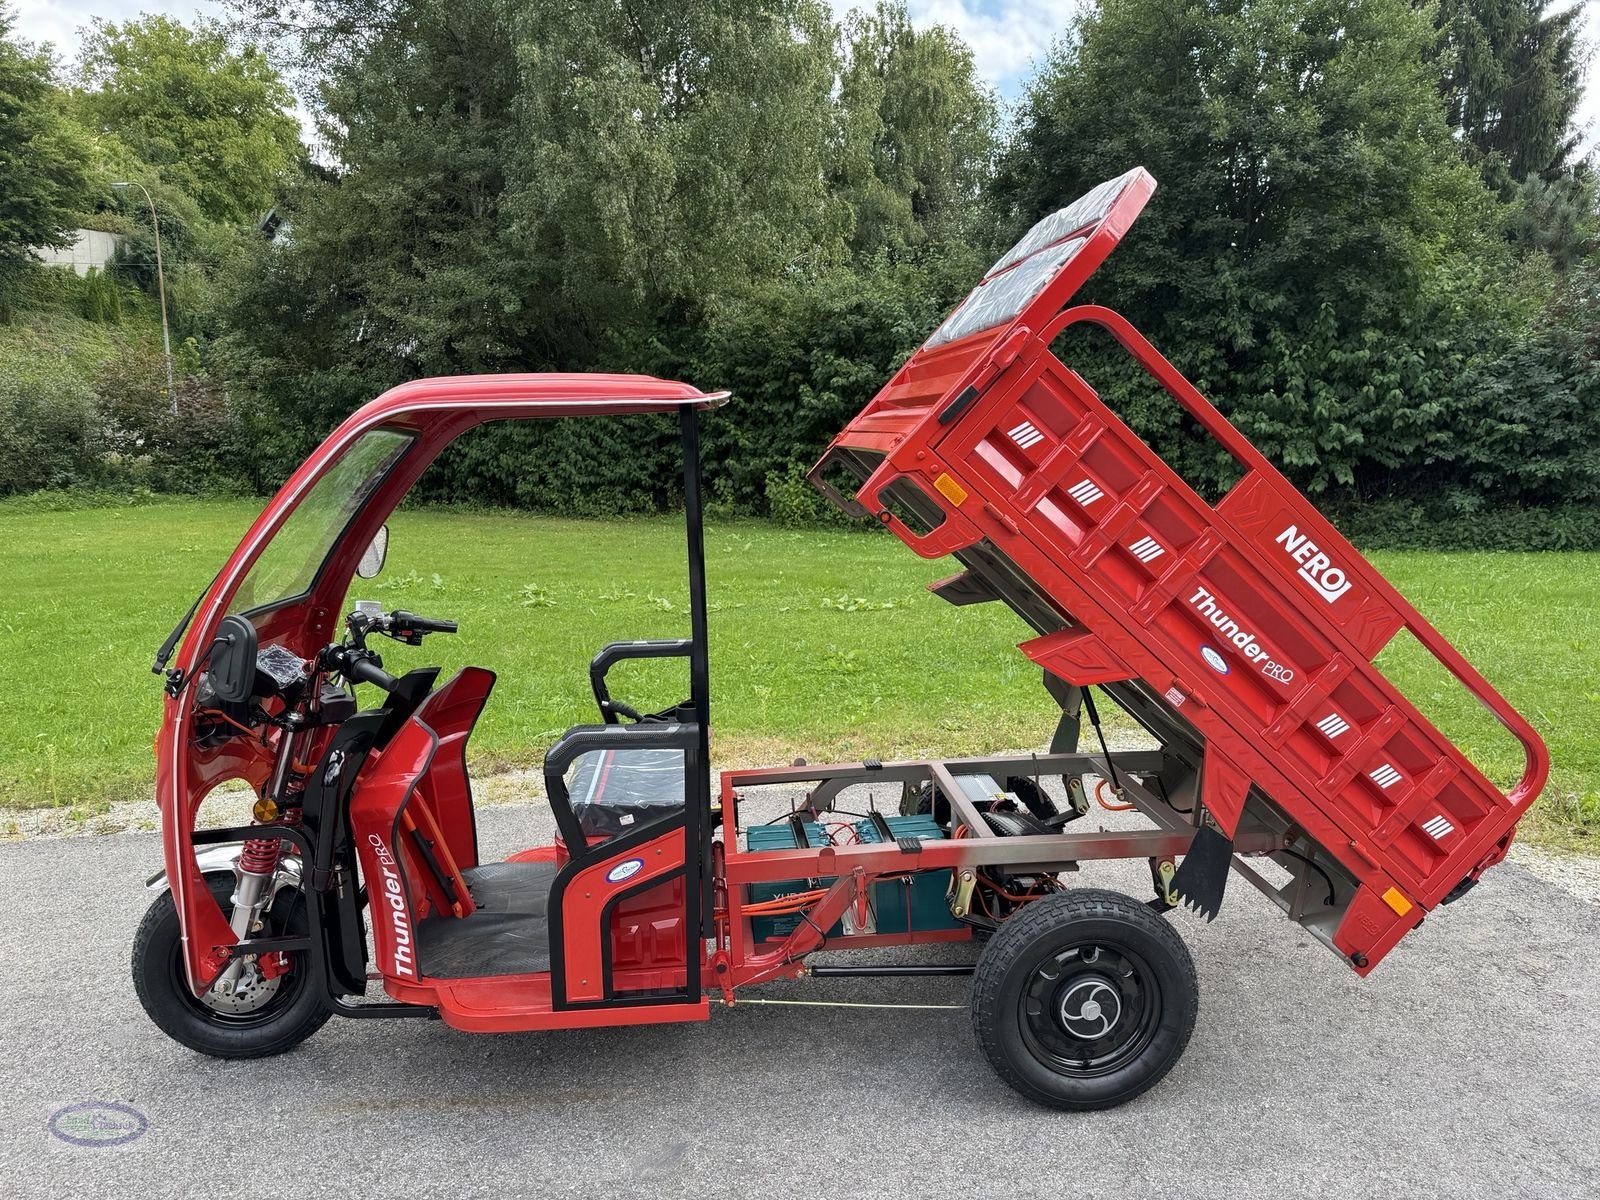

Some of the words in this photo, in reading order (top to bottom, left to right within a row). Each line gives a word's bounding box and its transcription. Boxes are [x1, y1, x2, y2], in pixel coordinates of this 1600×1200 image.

[1275, 524, 1347, 594] NERO
[1189, 586, 1270, 663] Thunder
[1261, 660, 1294, 683] PRO
[368, 832, 395, 865] PRO
[383, 866, 412, 976] Thunder
